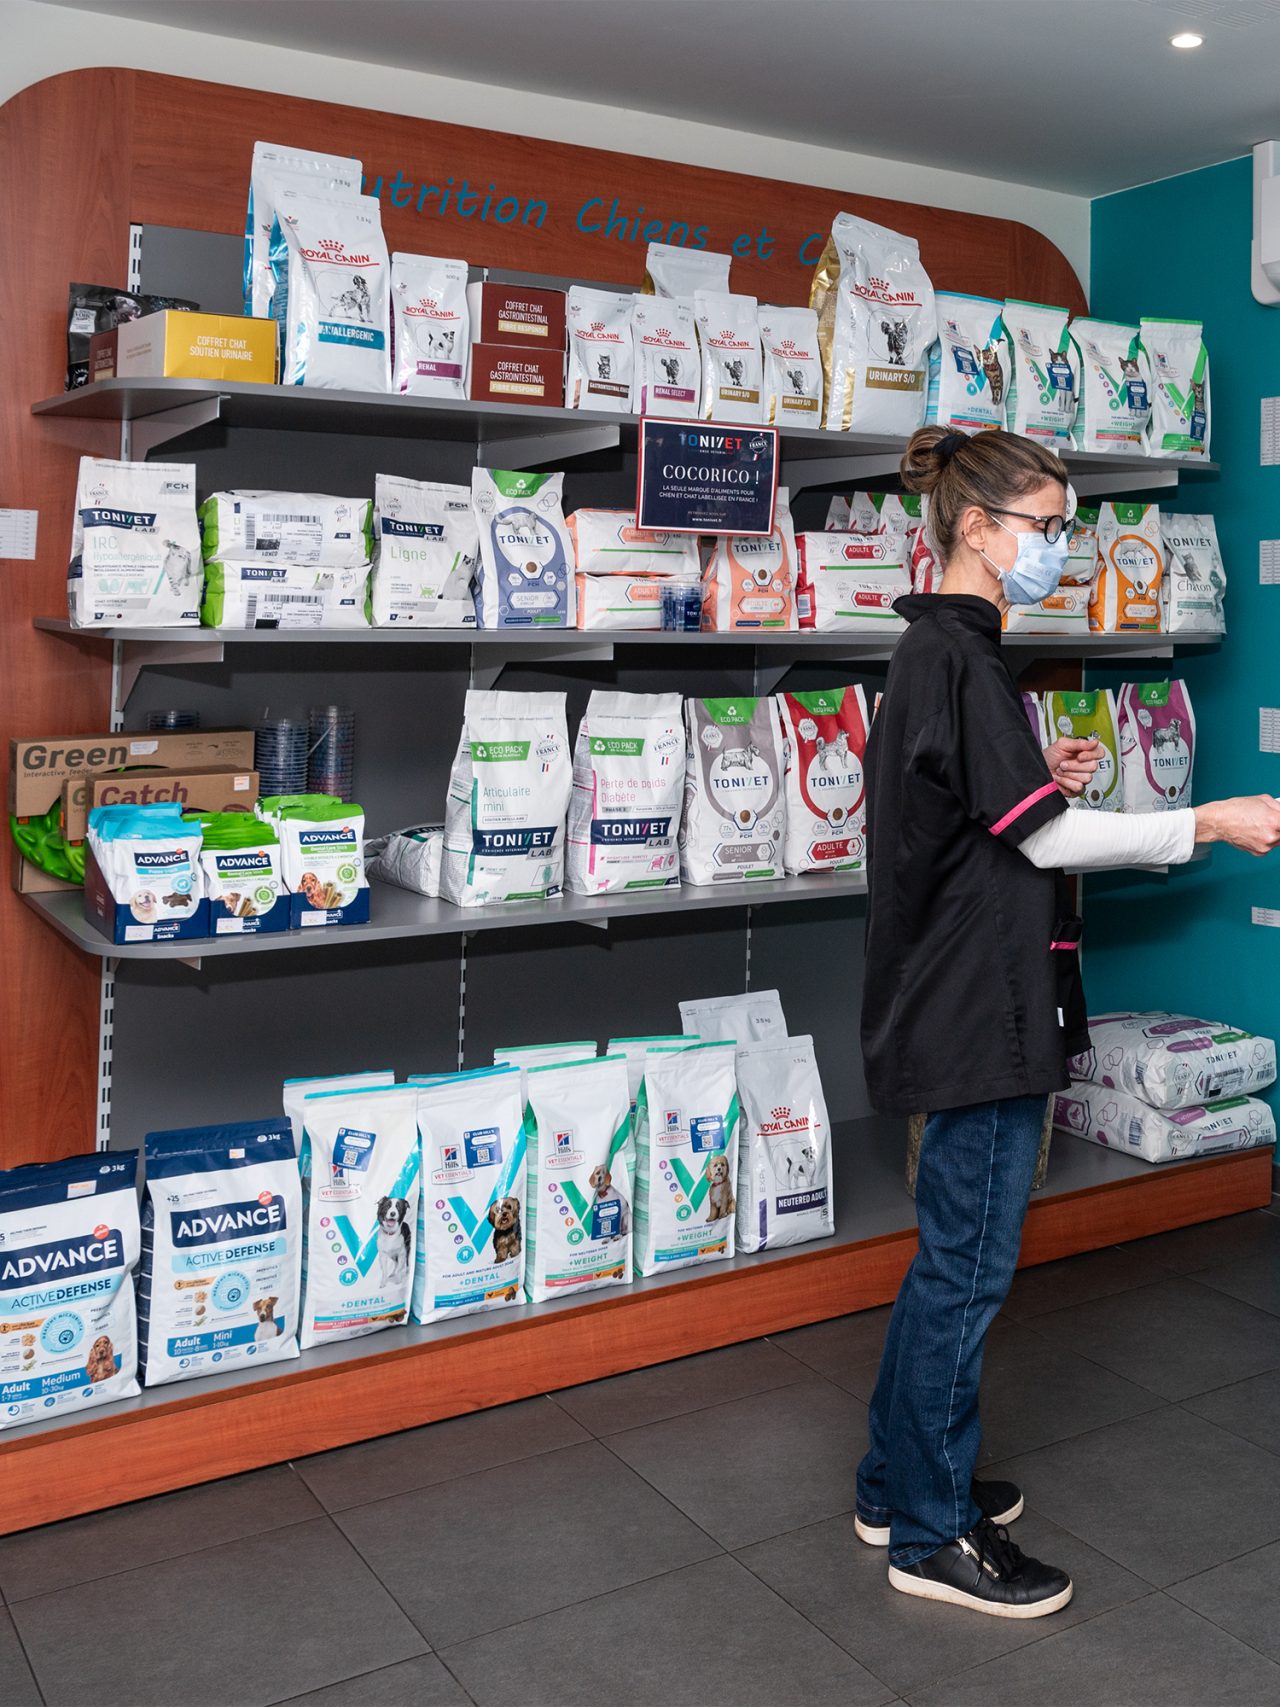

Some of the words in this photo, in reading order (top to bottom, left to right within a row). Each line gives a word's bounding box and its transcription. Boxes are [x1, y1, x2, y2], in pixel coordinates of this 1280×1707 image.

[361, 169, 548, 234] utrition
[576, 196, 710, 252] Chiens
[733, 226, 776, 261] et
[299, 247, 332, 262] ROYAL
[333, 252, 370, 264] CANIN
[855, 283, 882, 300] ROYAL
[882, 289, 915, 303] CANIN
[405, 306, 428, 317] ROYAL
[428, 308, 454, 318] CANIN
[505, 300, 526, 310] COFFRET
[527, 302, 543, 312] CHAT
[498, 308, 548, 325] GASTROINTESTINAL
[197, 336, 230, 348] COFFRET
[230, 338, 247, 349] CHAT
[597, 331, 620, 341] CANIN
[662, 339, 686, 348] CANIN
[190, 345, 220, 359] SOUTIEN
[220, 349, 254, 361] URINAIRE
[418, 361, 437, 371] RENAL
[497, 361, 520, 372] COFFRET
[521, 363, 539, 373] CHAT
[490, 369, 545, 384] GASTROINTESTINAL
[868, 370, 902, 382] URINARY
[903, 372, 916, 384] S/O
[662, 463, 750, 485] COCORICO
[755, 470, 760, 485] !
[165, 482, 189, 491] FCH
[710, 486, 740, 495] D'ALIMENTS
[659, 491, 676, 499] CHIEN
[736, 495, 755, 503] FRANCE
[133, 526, 158, 534] LAB
[92, 535, 118, 550] IRC
[425, 535, 445, 543] LAB
[390, 545, 428, 563] Ligne
[1177, 578, 1213, 594] Chaton
[489, 745, 504, 755] ECO
[504, 744, 524, 754] PACK
[607, 741, 621, 750] ECO
[22, 744, 128, 771] Green
[24, 768, 67, 779] Interactive
[601, 778, 625, 789] Perte
[628, 778, 639, 788] de
[641, 777, 667, 790] poids
[100, 781, 189, 806] Catch
[483, 785, 531, 799] Articulaire
[601, 791, 636, 804] Diabète
[483, 802, 505, 812] mini
[302, 831, 355, 844] ADVANCE
[648, 838, 670, 848] LAB
[530, 848, 554, 858] LAB
[725, 846, 753, 856] SENIOR
[817, 841, 845, 853] ADULTE
[136, 852, 187, 864] ADVANCE
[219, 856, 270, 868] ADVANCE
[778, 1194, 811, 1209] NEUTERED
[177, 1205, 281, 1240] ADVANCE
[1, 1239, 118, 1281] ADVANCE
[174, 1337, 202, 1350] Adult
[213, 1330, 233, 1344] Mini
[42, 1371, 82, 1389] Medium
[1, 1382, 31, 1395] Adult
